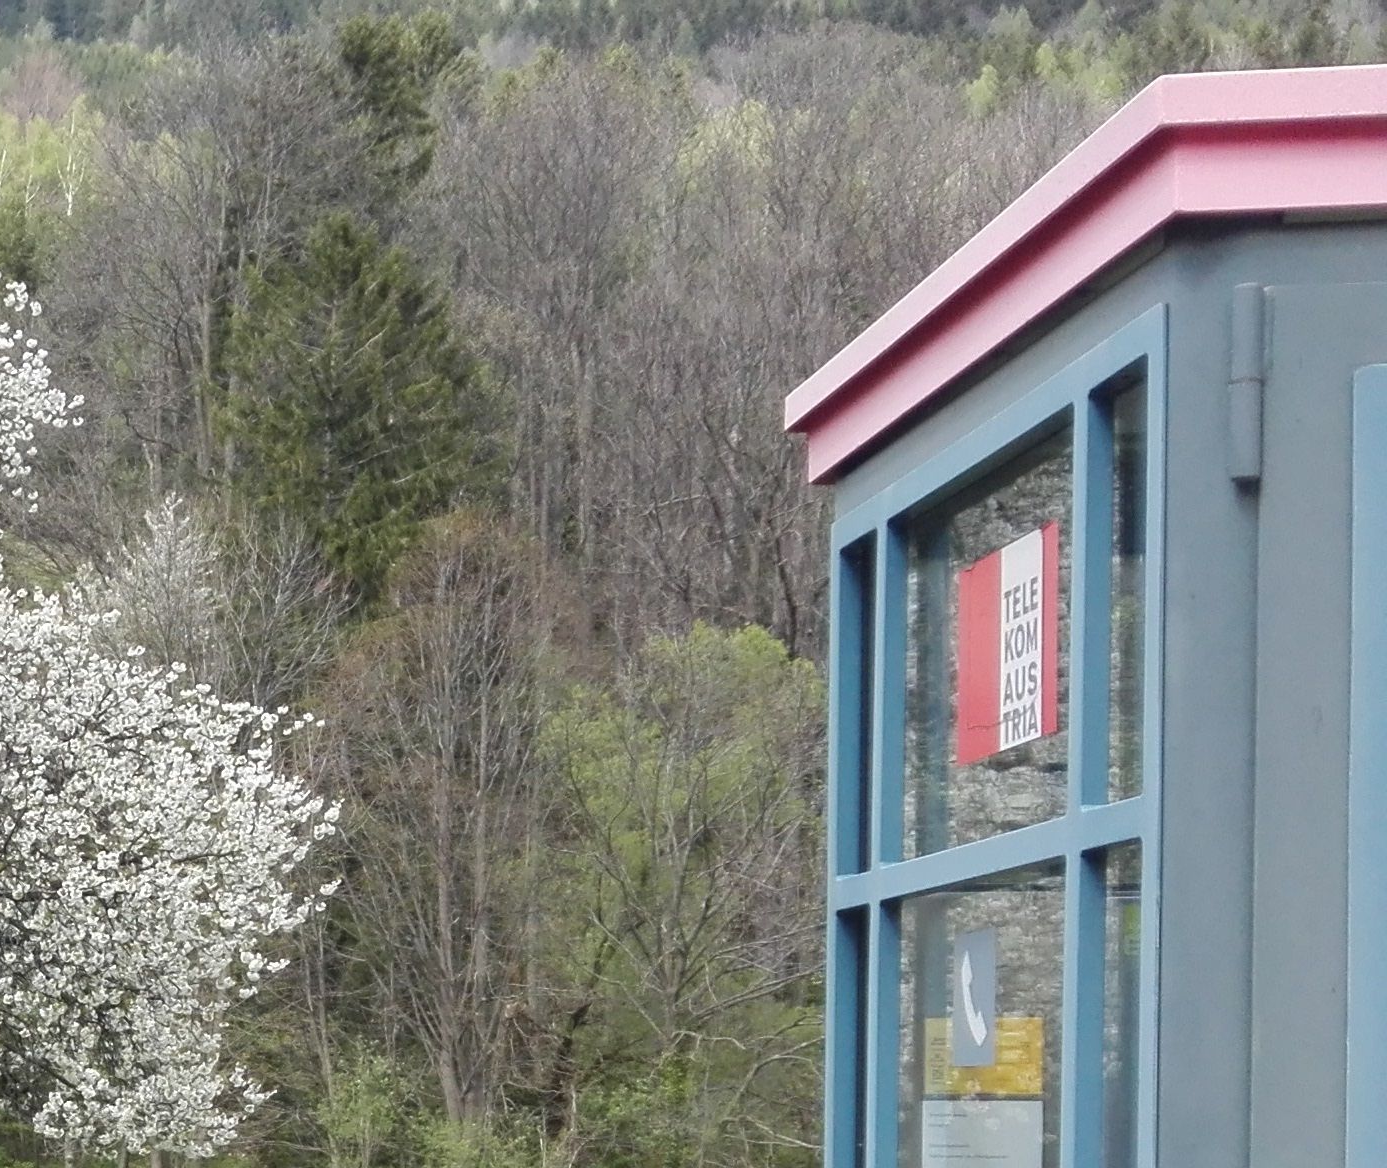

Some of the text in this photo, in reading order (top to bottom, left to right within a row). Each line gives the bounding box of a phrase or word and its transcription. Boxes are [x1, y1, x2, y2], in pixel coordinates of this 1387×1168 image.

[1003, 576, 1038, 623] TELE
[1004, 622, 1037, 664] KOM
[1003, 661, 1038, 706] AUS
[1003, 702, 1038, 744] TRIA
